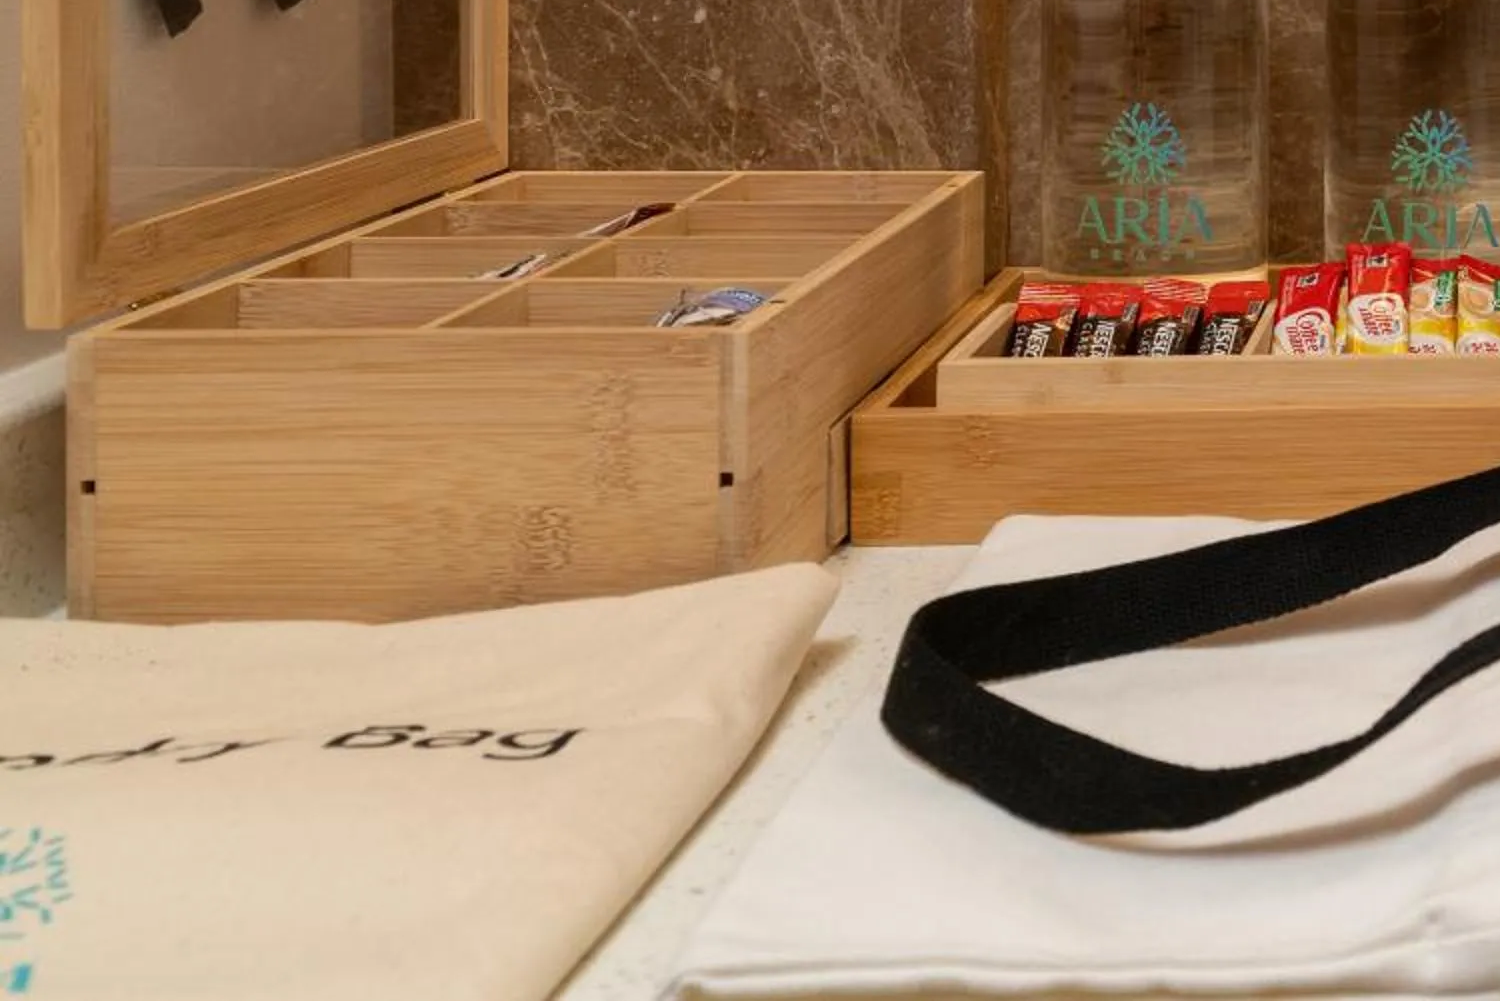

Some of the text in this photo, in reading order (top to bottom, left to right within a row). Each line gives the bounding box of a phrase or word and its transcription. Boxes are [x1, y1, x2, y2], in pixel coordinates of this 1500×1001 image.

[1076, 193, 1214, 246] ARIA
[1360, 199, 1500, 250] ARIA
[322, 724, 586, 762] Bag
